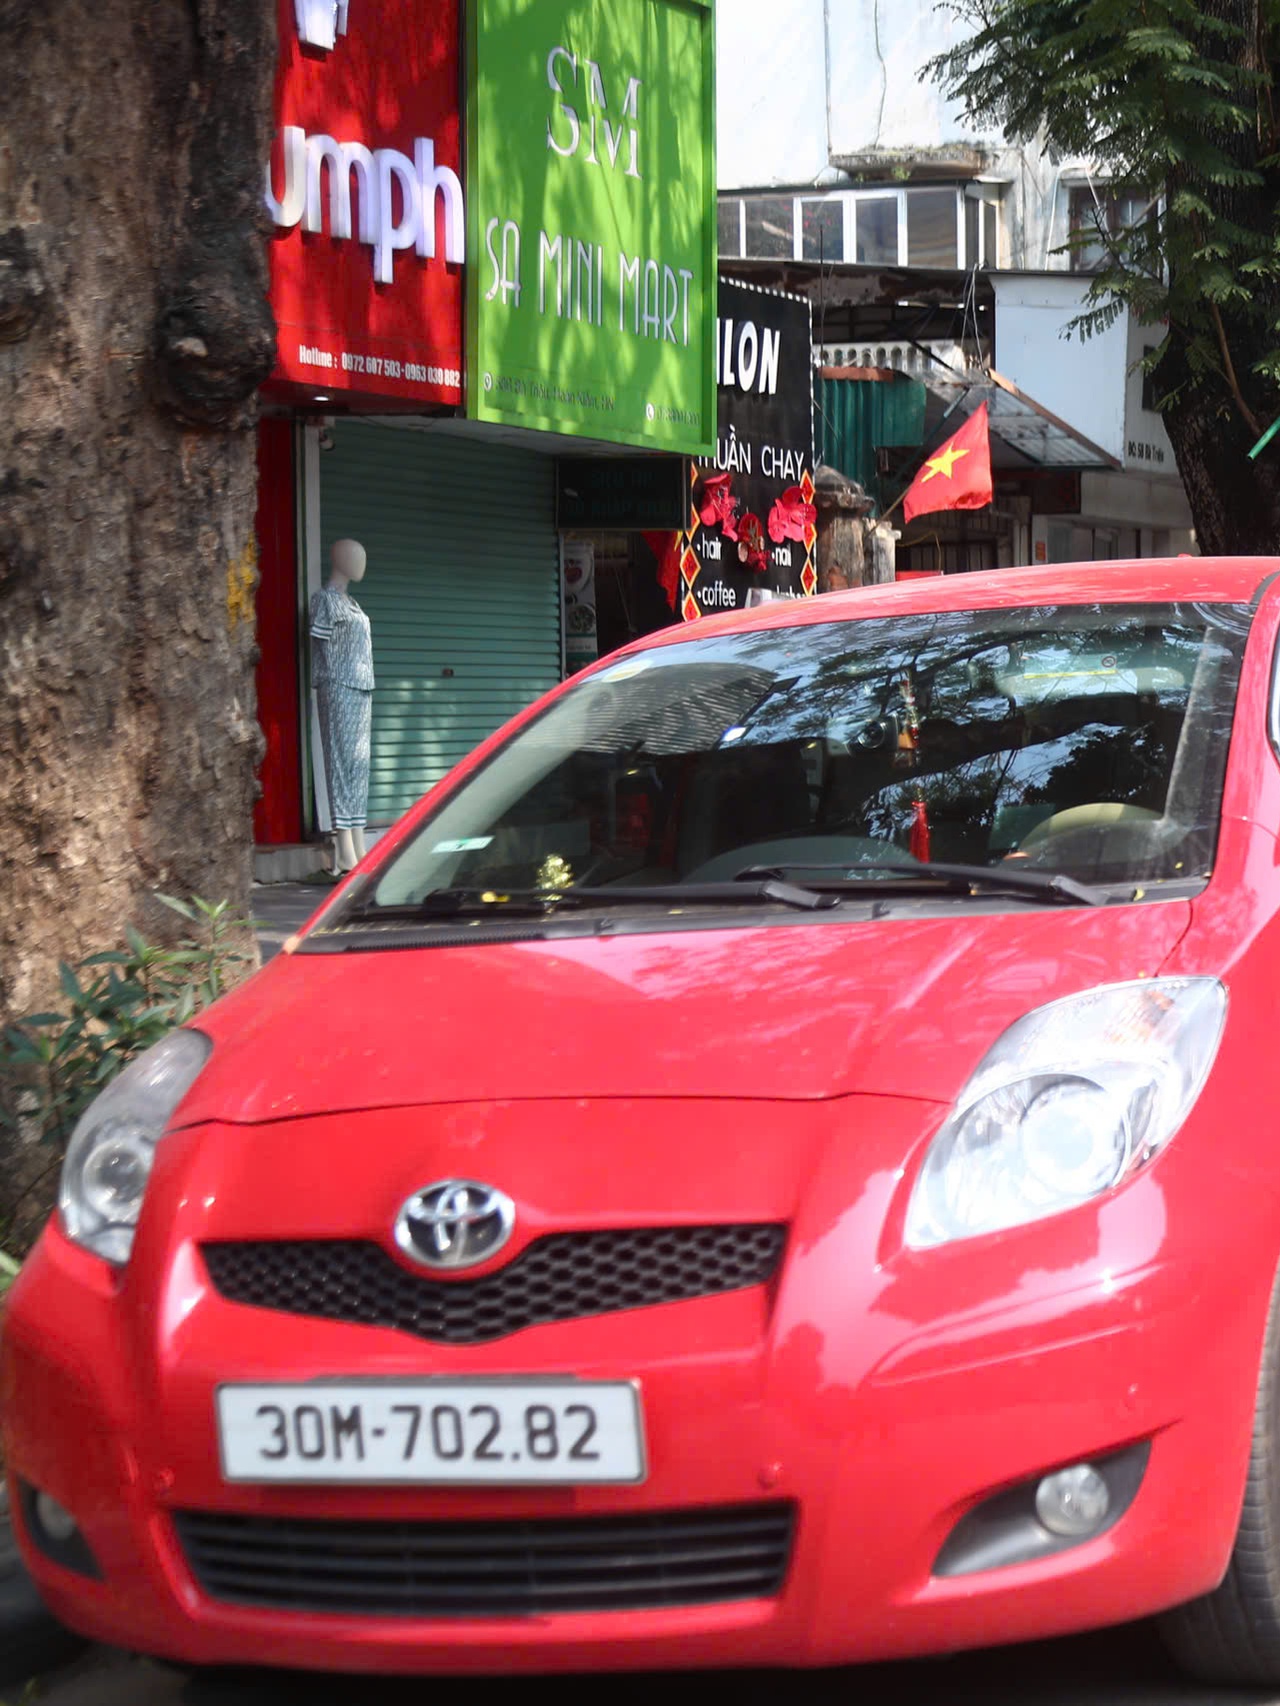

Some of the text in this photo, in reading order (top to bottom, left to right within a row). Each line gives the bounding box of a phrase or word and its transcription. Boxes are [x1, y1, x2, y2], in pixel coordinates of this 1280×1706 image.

[485, 216, 694, 346] SA MINI MART
[342, 352, 365, 373] 0972
[716, 318, 781, 395] LON
[761, 445, 804, 481] CHAY
[702, 533, 722, 561] hair
[775, 544, 792, 567] nail
[702, 580, 736, 608] coffee
[256, 1404, 600, 1462] 30M-702.82
